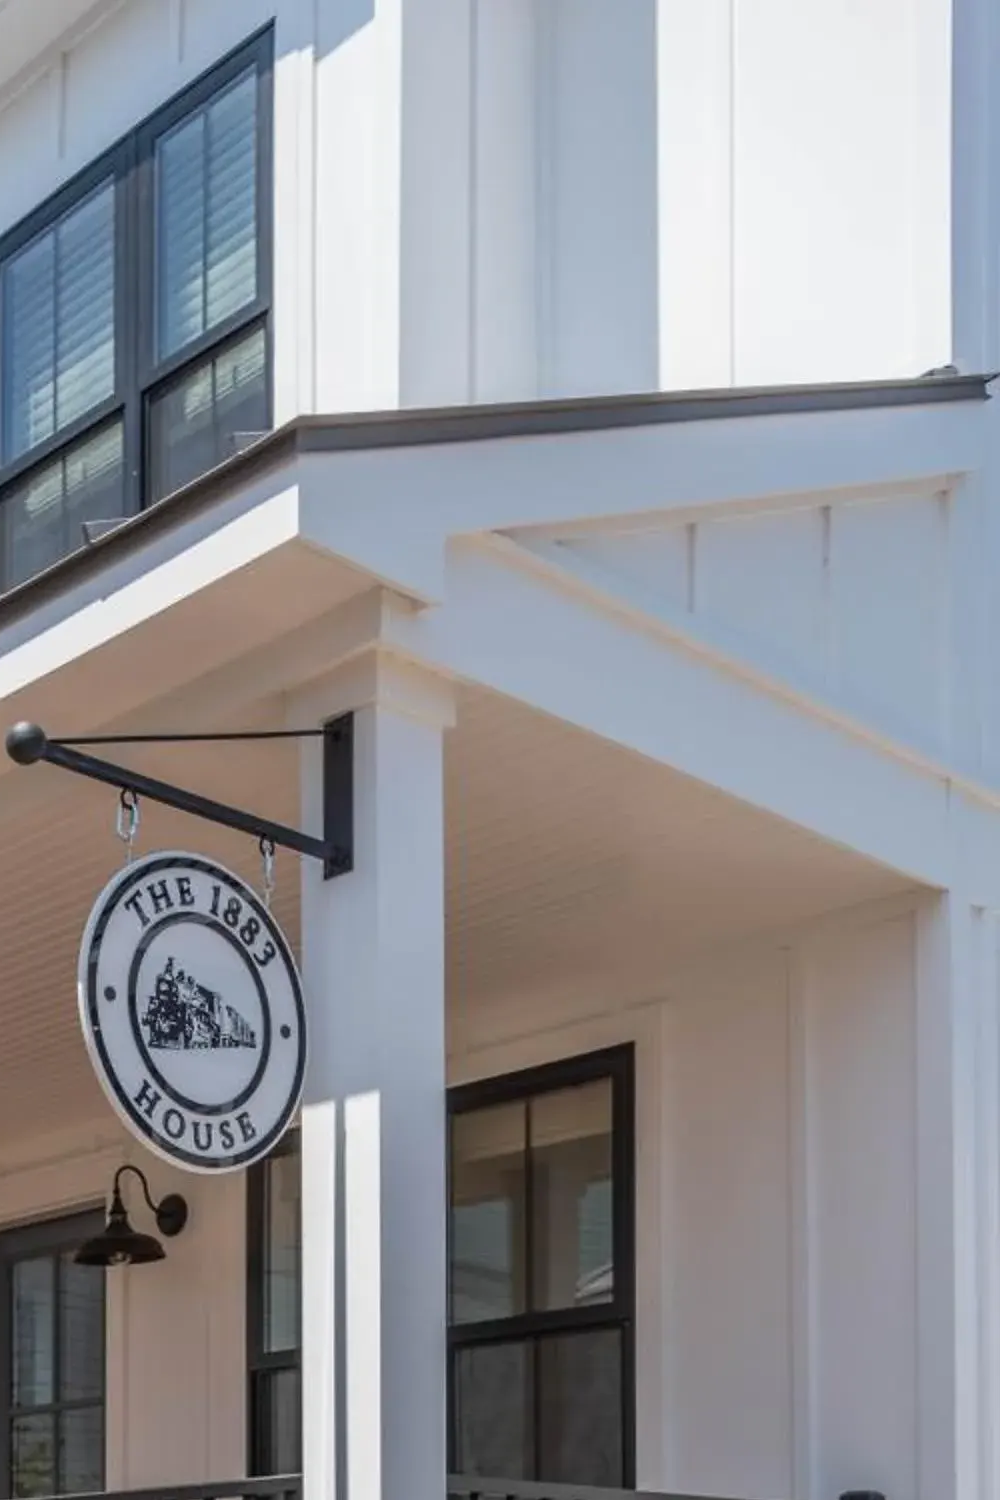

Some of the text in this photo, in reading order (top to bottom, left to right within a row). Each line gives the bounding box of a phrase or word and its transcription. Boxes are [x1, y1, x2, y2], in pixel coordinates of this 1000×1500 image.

[124, 877, 276, 967] THE 1883
[133, 1080, 256, 1151] HOUSE
